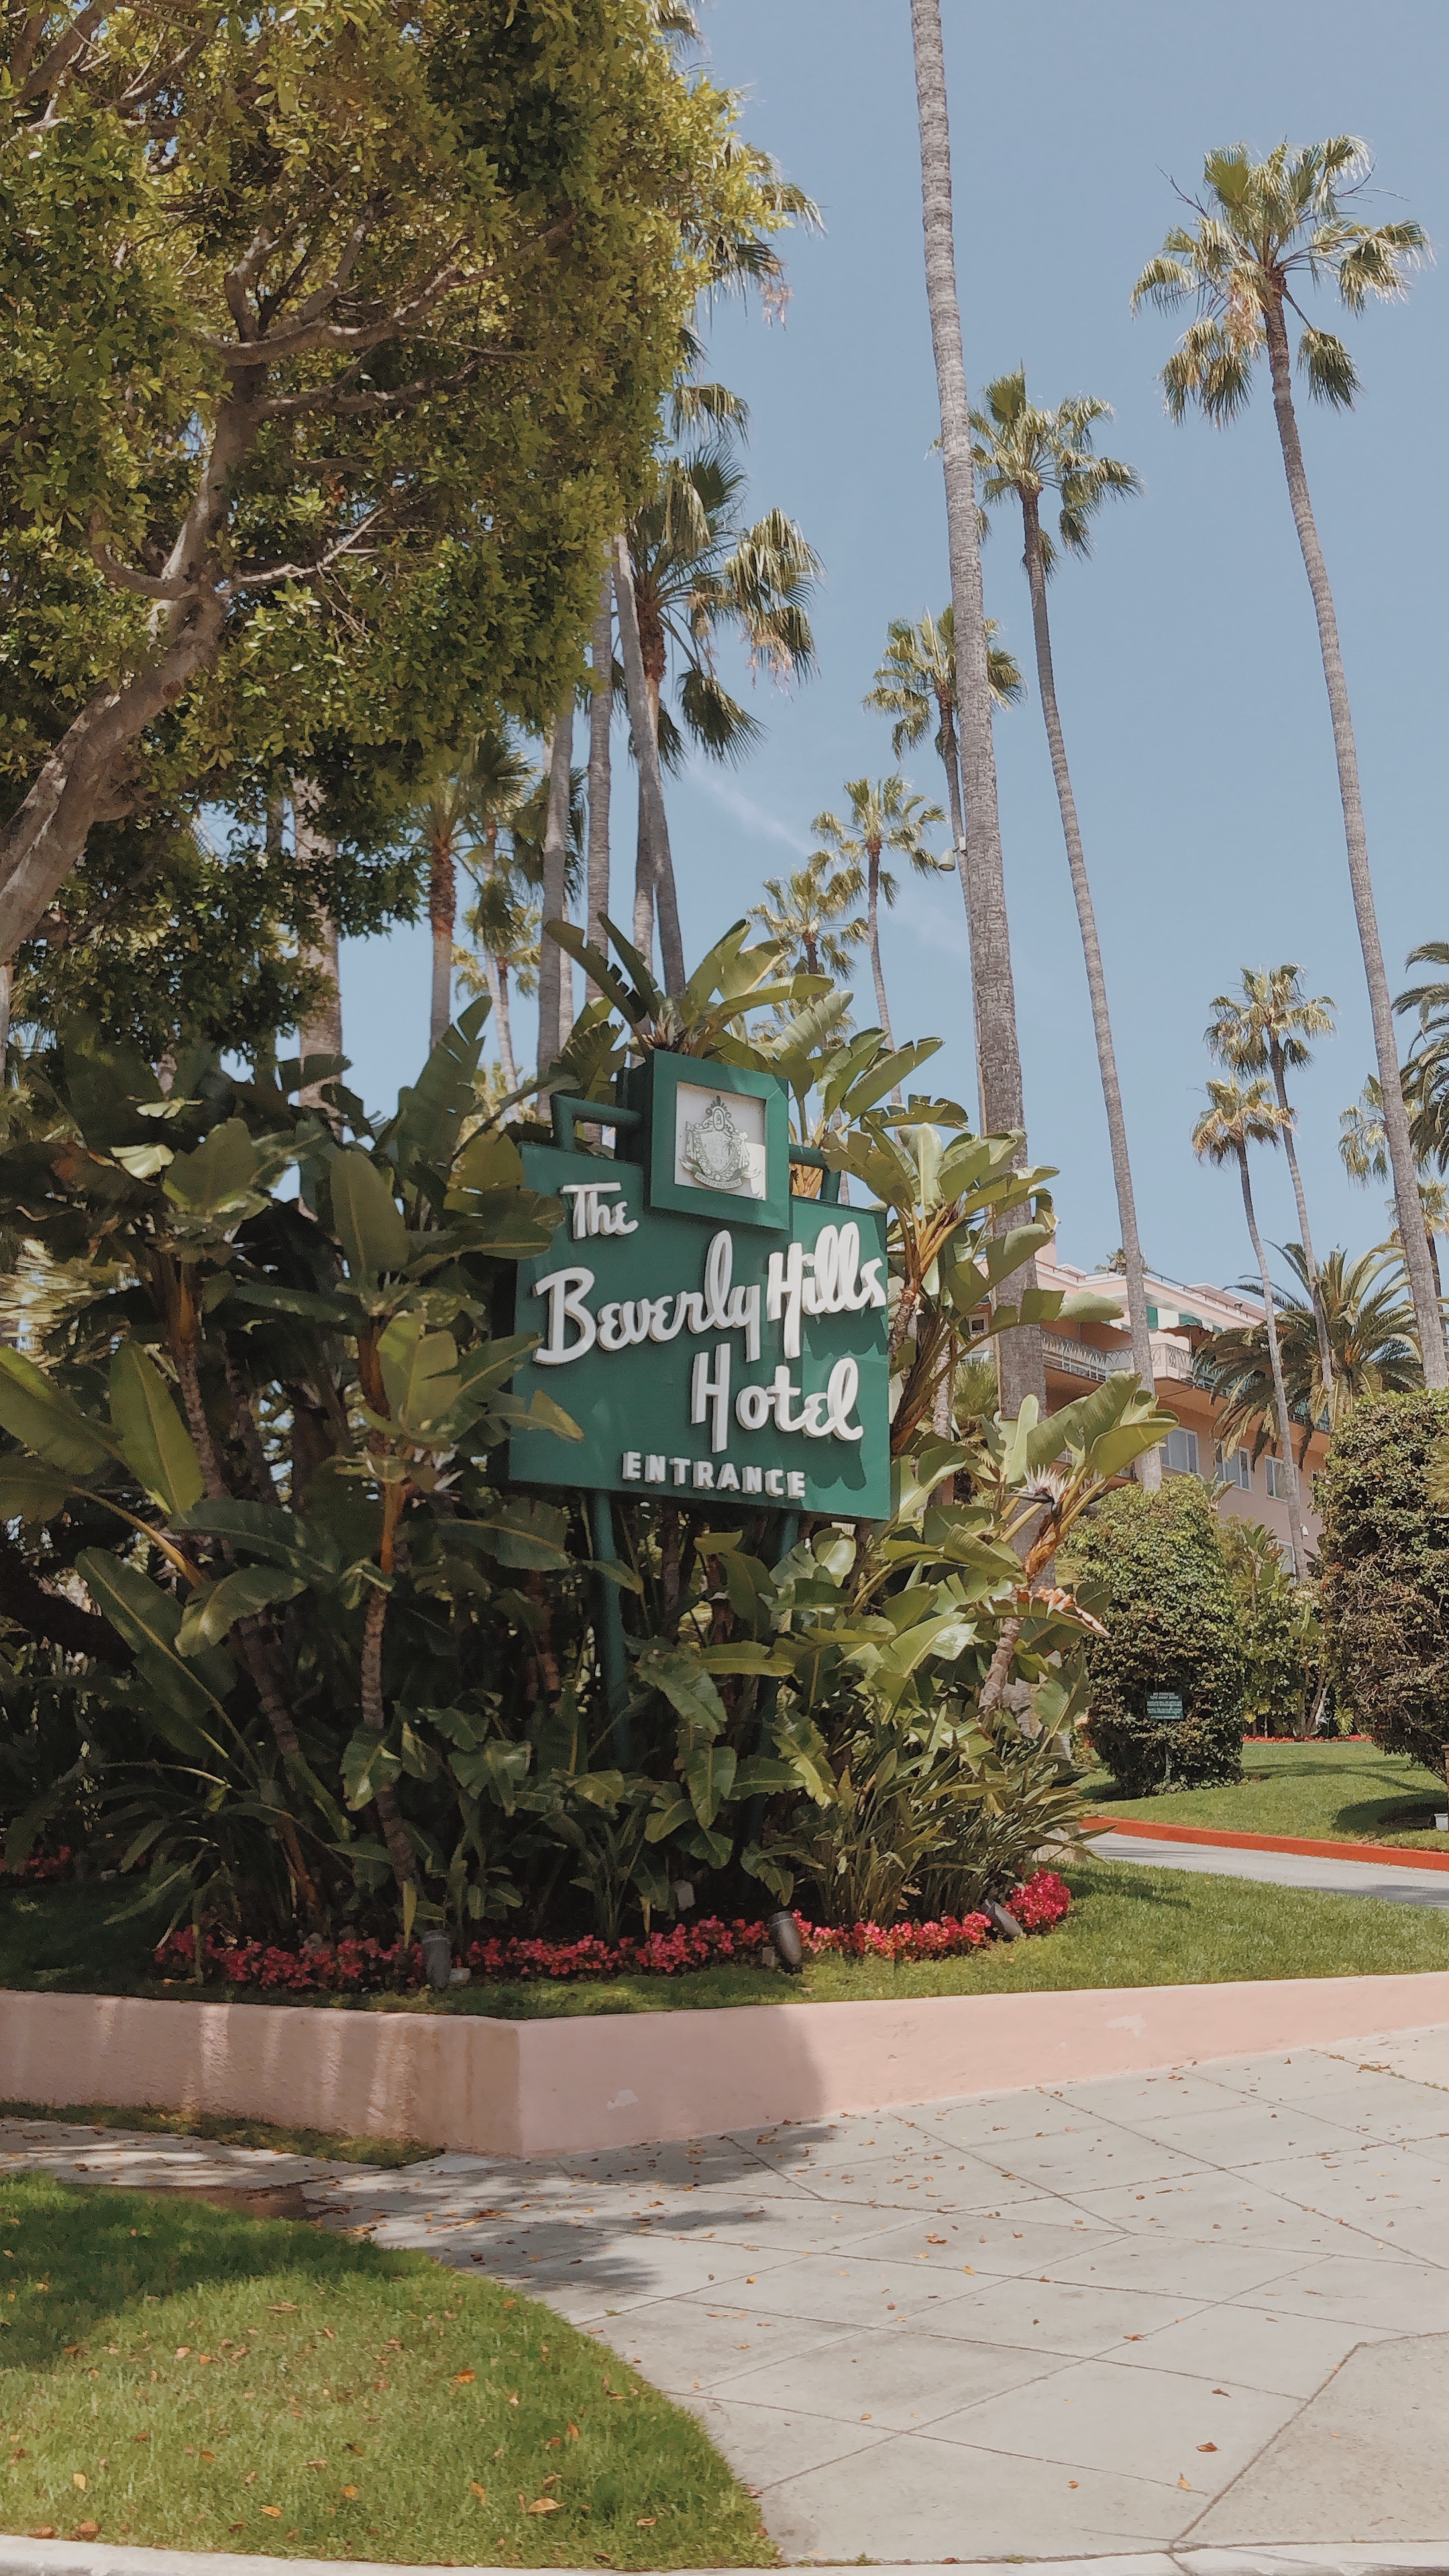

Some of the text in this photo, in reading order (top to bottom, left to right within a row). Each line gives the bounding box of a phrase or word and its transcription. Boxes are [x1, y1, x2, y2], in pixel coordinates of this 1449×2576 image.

[561, 1183, 639, 1240] The
[533, 1222, 886, 1364] Beverly Hills
[692, 1344, 863, 1452] Hotel
[622, 1452, 806, 1498] ENTRANCE
